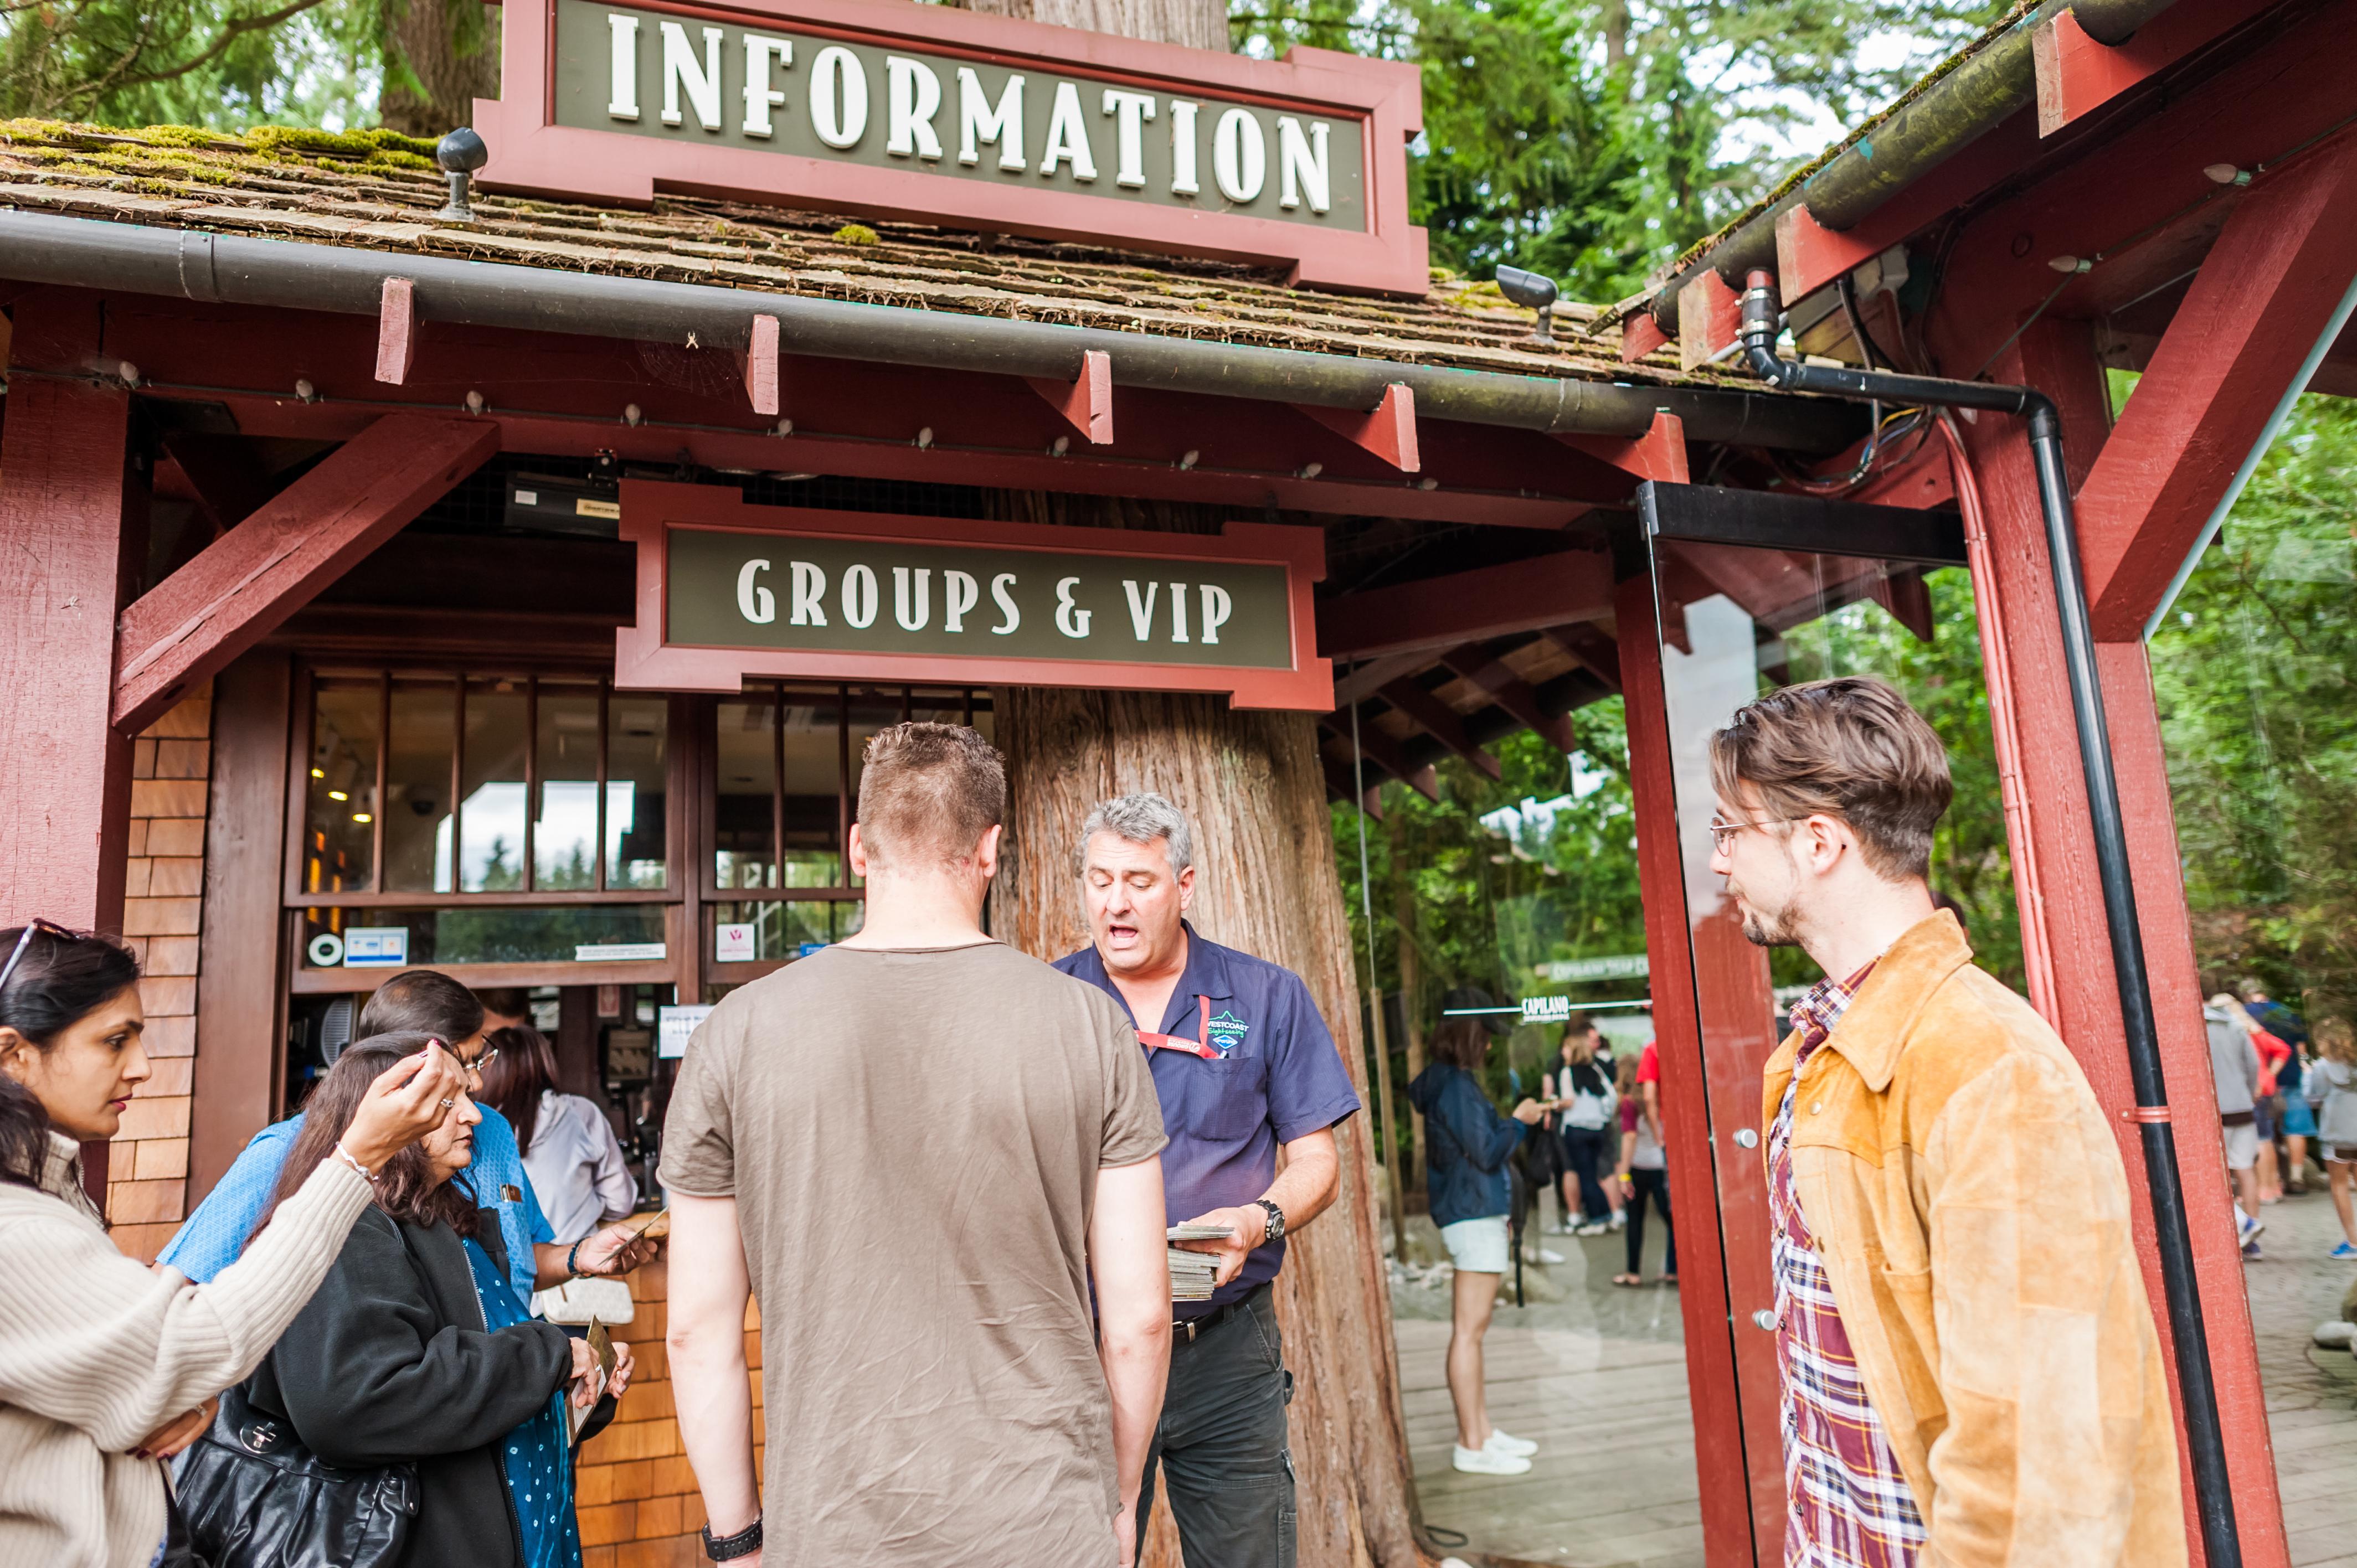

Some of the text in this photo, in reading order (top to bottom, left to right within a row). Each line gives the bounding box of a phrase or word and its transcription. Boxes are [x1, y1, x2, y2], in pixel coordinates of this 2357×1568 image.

[608, 14, 1329, 213] INFORMATION
[737, 559, 1232, 644] GROUPS & VIP
[1521, 995, 1569, 1015] CAPILANO
